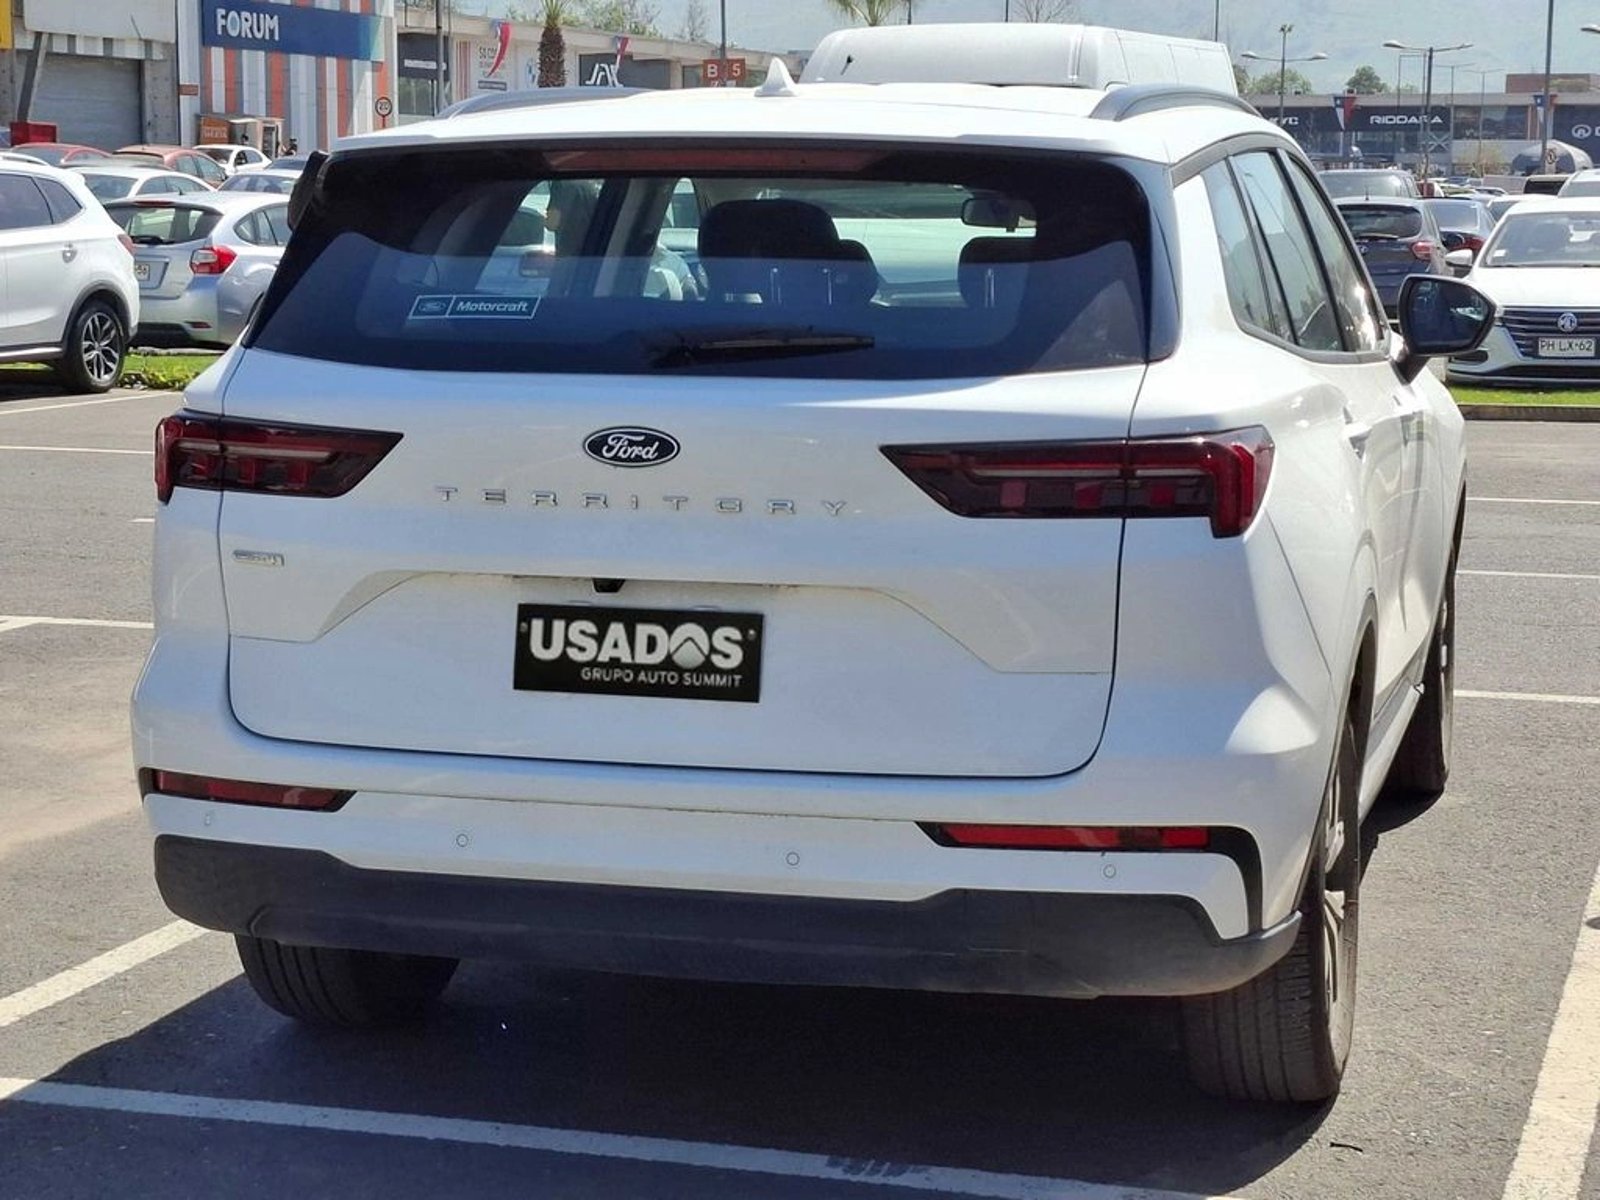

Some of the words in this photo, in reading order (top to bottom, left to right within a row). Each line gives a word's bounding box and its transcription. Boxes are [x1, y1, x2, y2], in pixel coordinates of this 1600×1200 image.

[215, 8, 280, 41] FORUM
[707, 63, 718, 77] B
[732, 63, 741, 77] 5
[456, 301, 529, 312] Motorcraft
[602, 433, 659, 460] Ford
[434, 486, 846, 515] TERRITORY
[529, 618, 744, 670] USADOS
[580, 667, 634, 683] GRUPO
[637, 669, 679, 686] AUTO
[682, 672, 743, 689] SUMMIT
